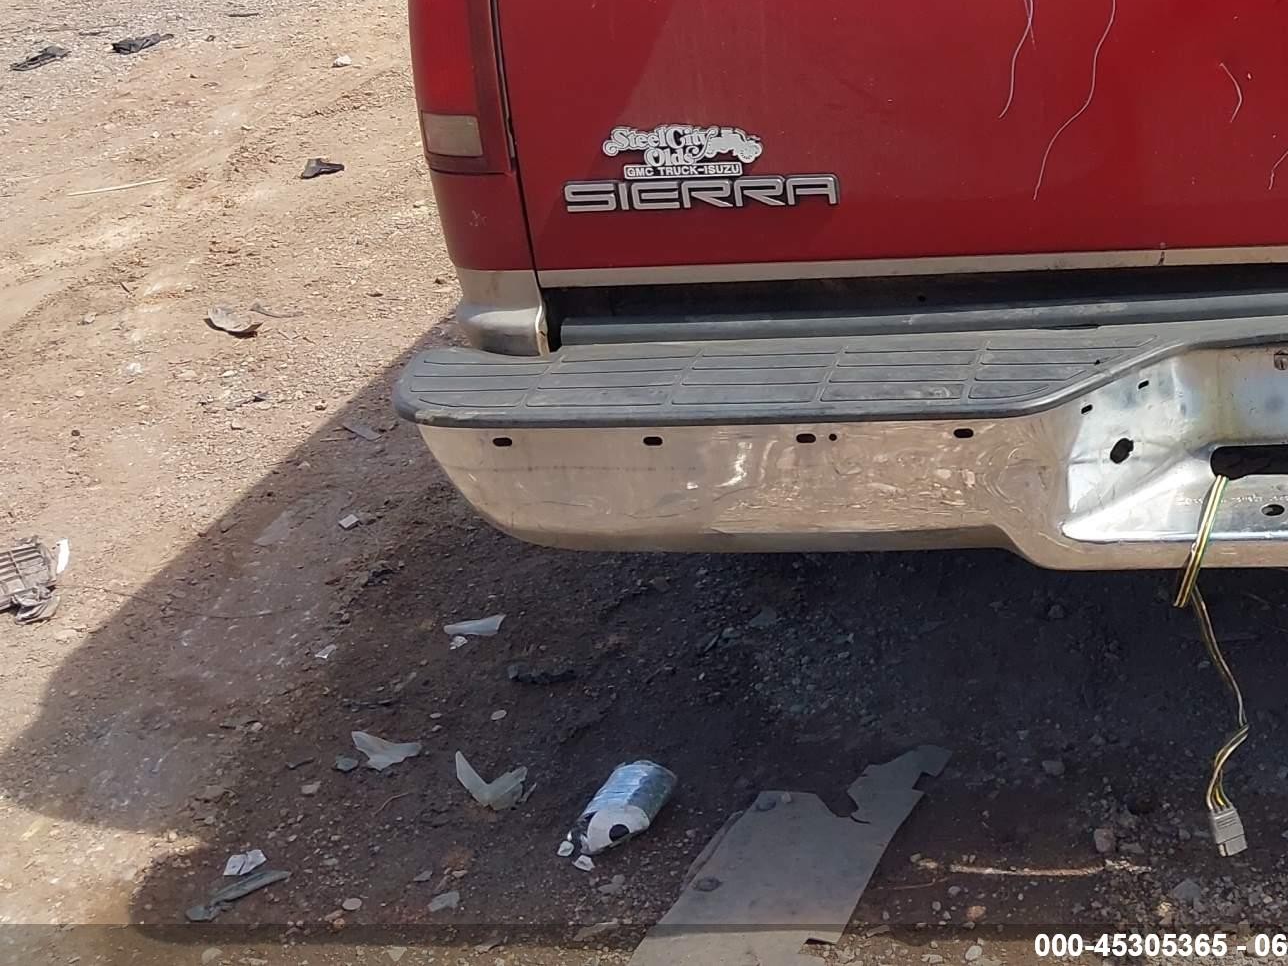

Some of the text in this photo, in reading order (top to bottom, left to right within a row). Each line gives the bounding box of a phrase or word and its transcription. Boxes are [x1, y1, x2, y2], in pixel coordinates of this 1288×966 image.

[603, 125, 717, 159] Steel City
[644, 146, 697, 167] Olds
[626, 166, 654, 178] GMC
[564, 174, 839, 212] SIERRA
